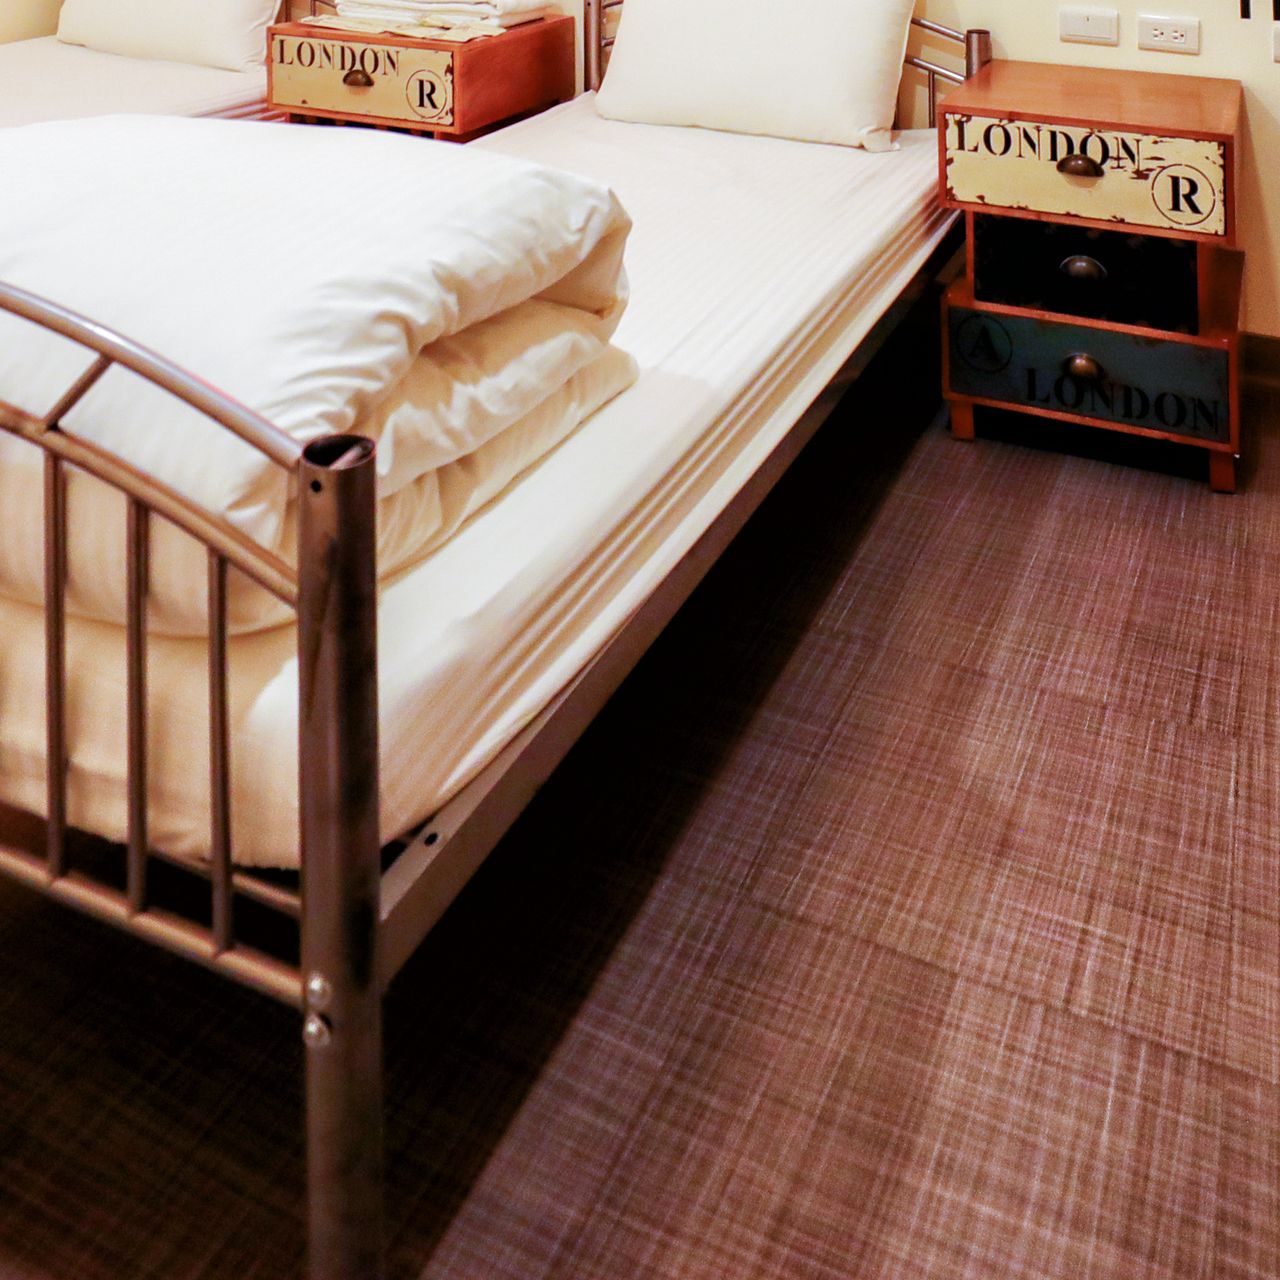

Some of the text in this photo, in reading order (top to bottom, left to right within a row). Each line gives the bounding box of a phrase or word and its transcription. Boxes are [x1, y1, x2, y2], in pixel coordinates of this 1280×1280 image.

[278, 38, 400, 76] LONDON
[417, 78, 438, 110] R
[956, 119, 1141, 170] LONDON
[1166, 173, 1204, 216] R
[969, 324, 1001, 362] A
[1026, 367, 1219, 434] LONDON
